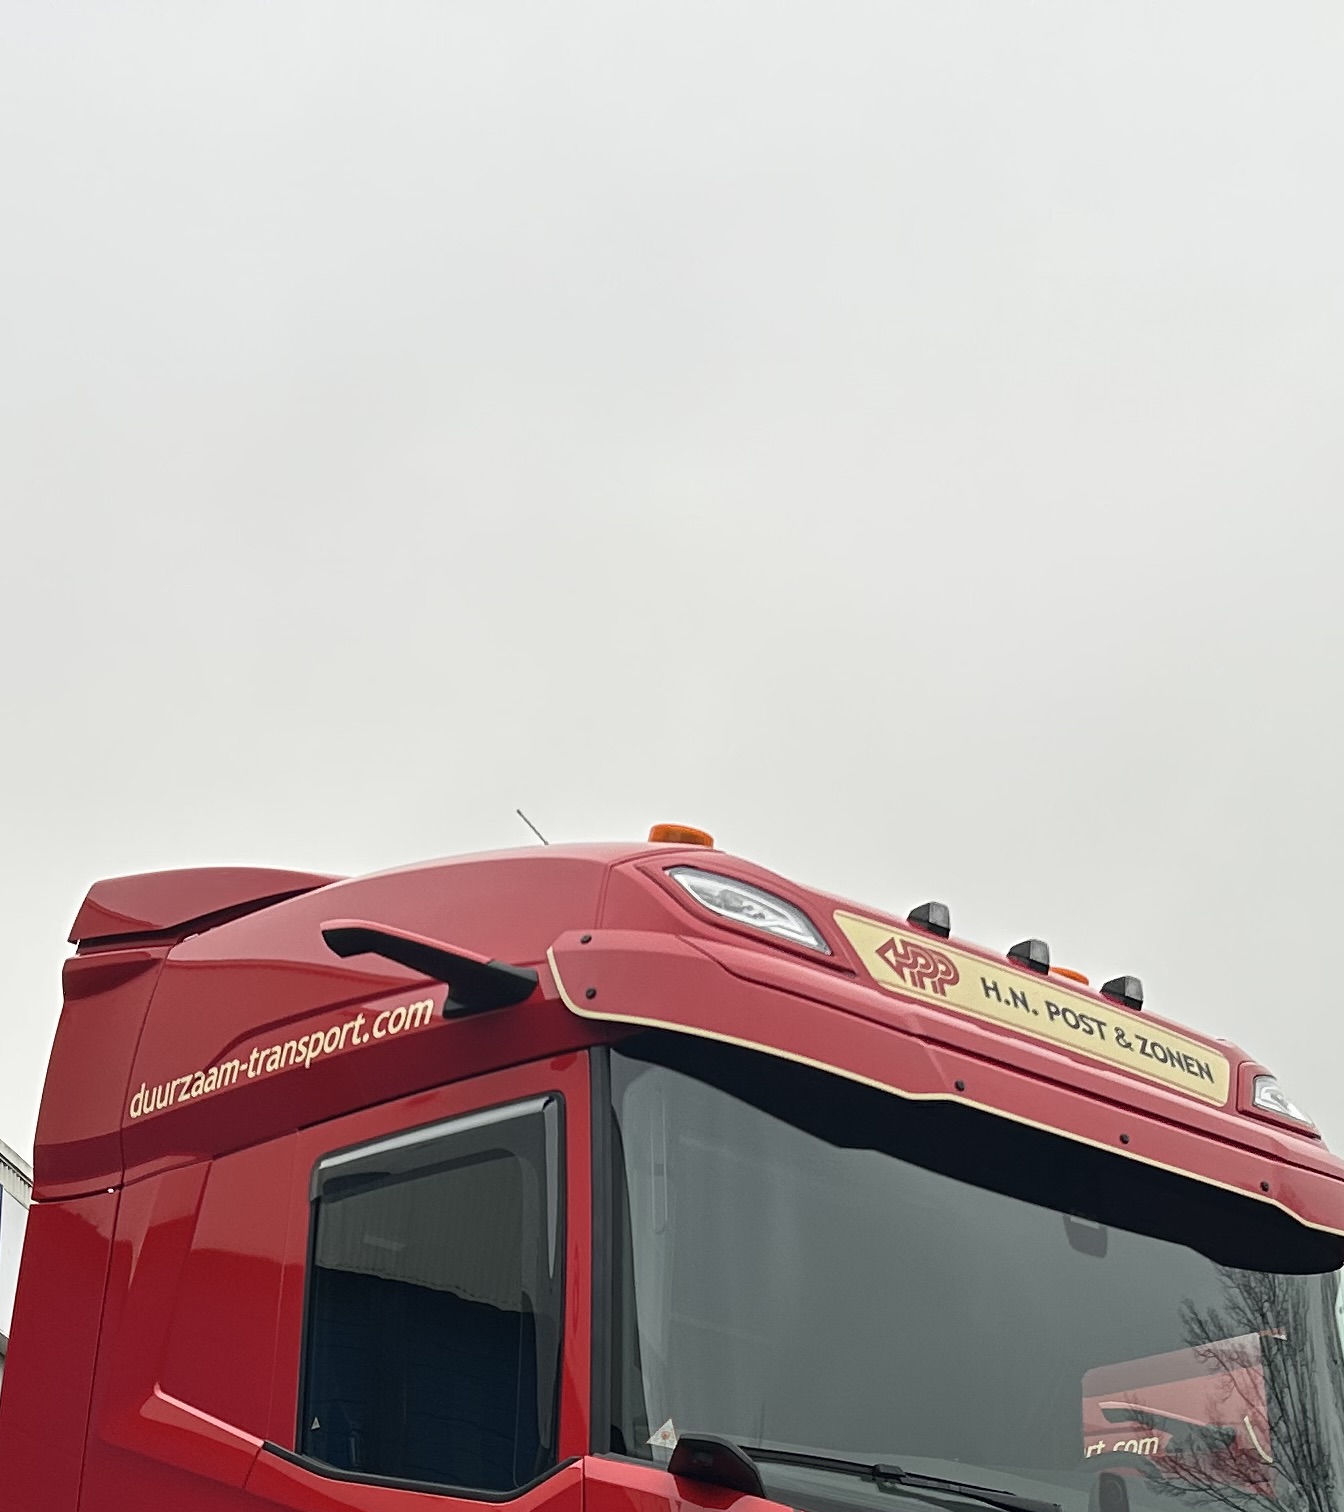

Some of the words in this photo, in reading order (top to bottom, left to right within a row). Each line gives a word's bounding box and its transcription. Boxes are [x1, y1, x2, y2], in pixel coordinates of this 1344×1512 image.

[129, 998, 434, 1119] duurzaam-transport.com
[980, 976, 1039, 1017] H.N.
[1046, 1000, 1107, 1042] POST
[1114, 1026, 1132, 1049] &
[1134, 1034, 1215, 1084] ZONEN
